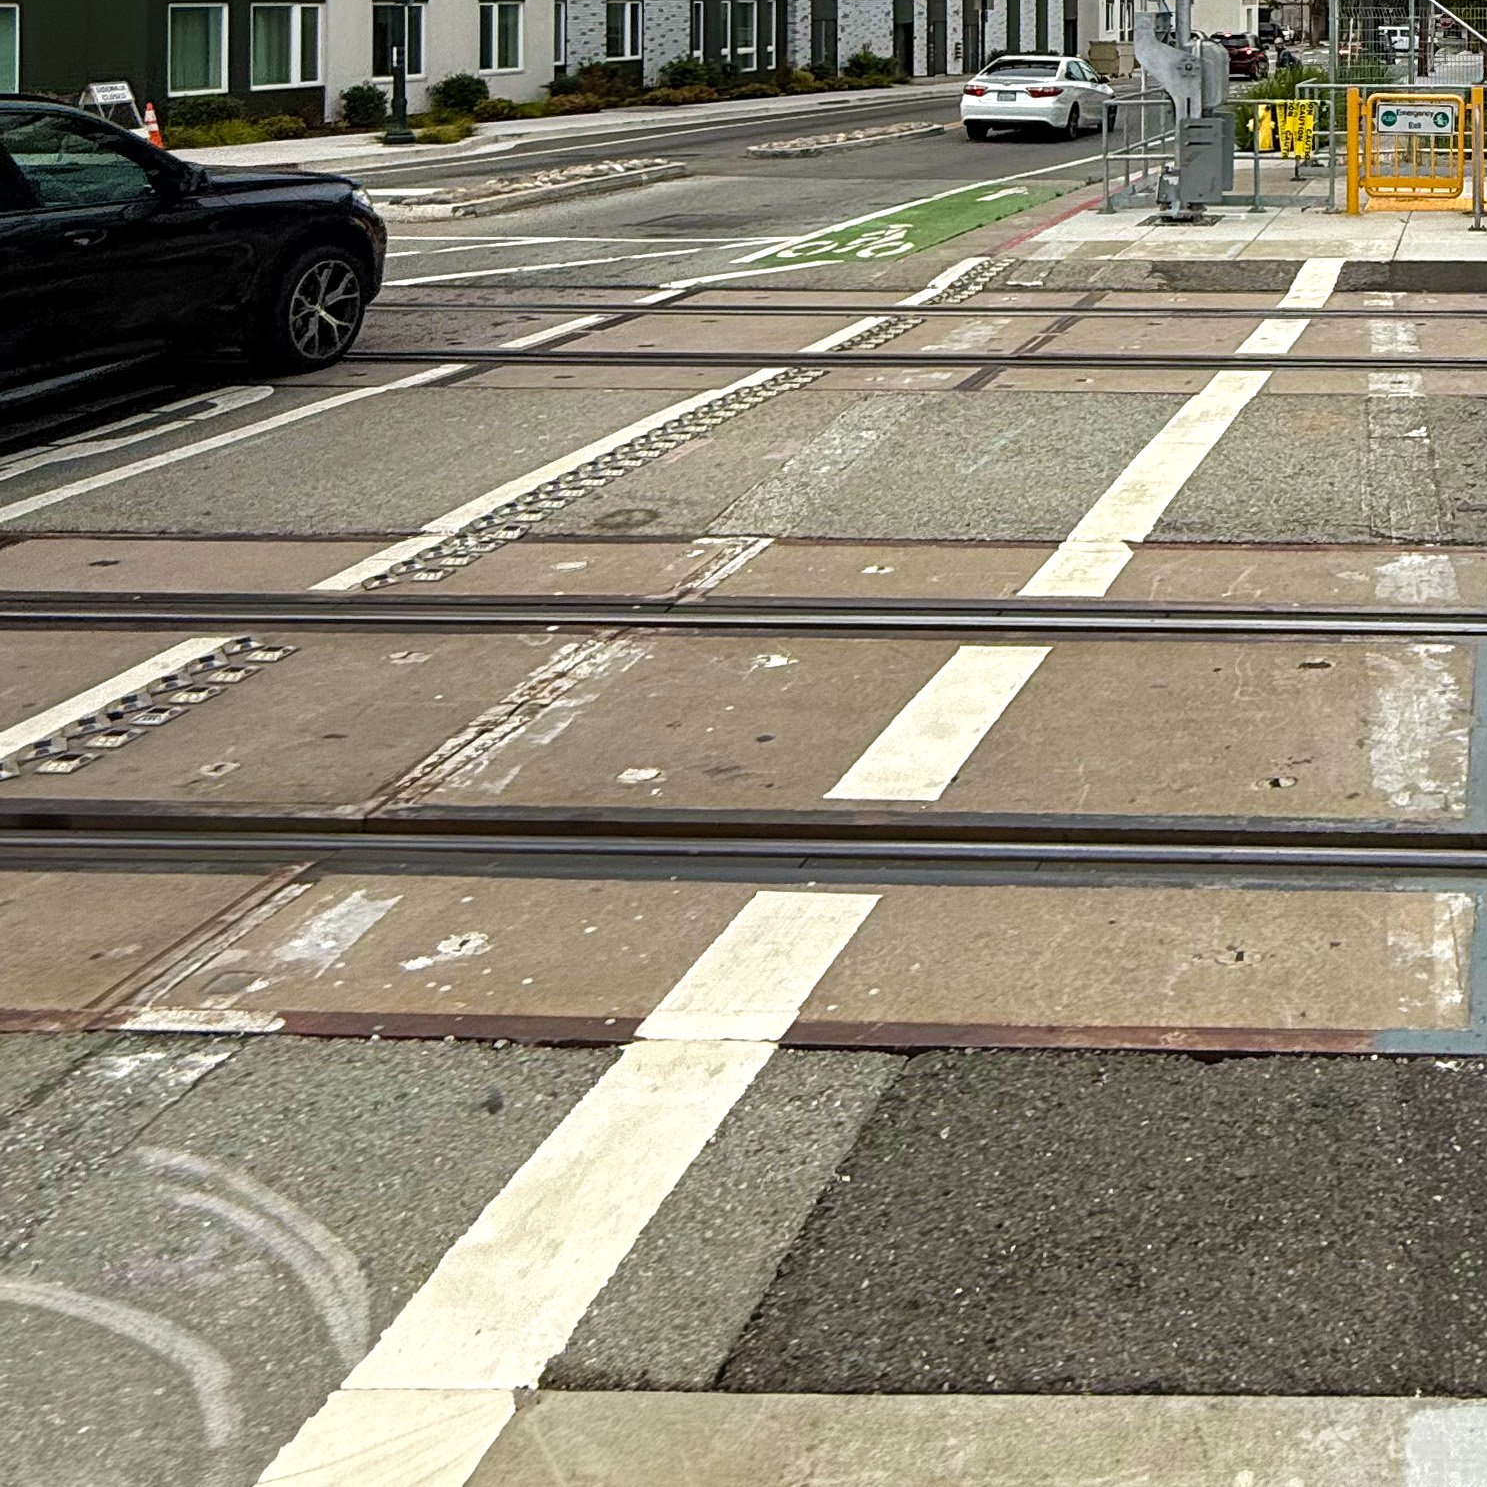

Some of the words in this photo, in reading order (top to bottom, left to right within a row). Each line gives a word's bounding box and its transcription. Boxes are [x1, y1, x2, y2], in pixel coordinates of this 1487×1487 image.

[1396, 108, 1435, 118] Emergency
[1297, 104, 1306, 142] CAUTION
[1408, 121, 1422, 129] Exit
